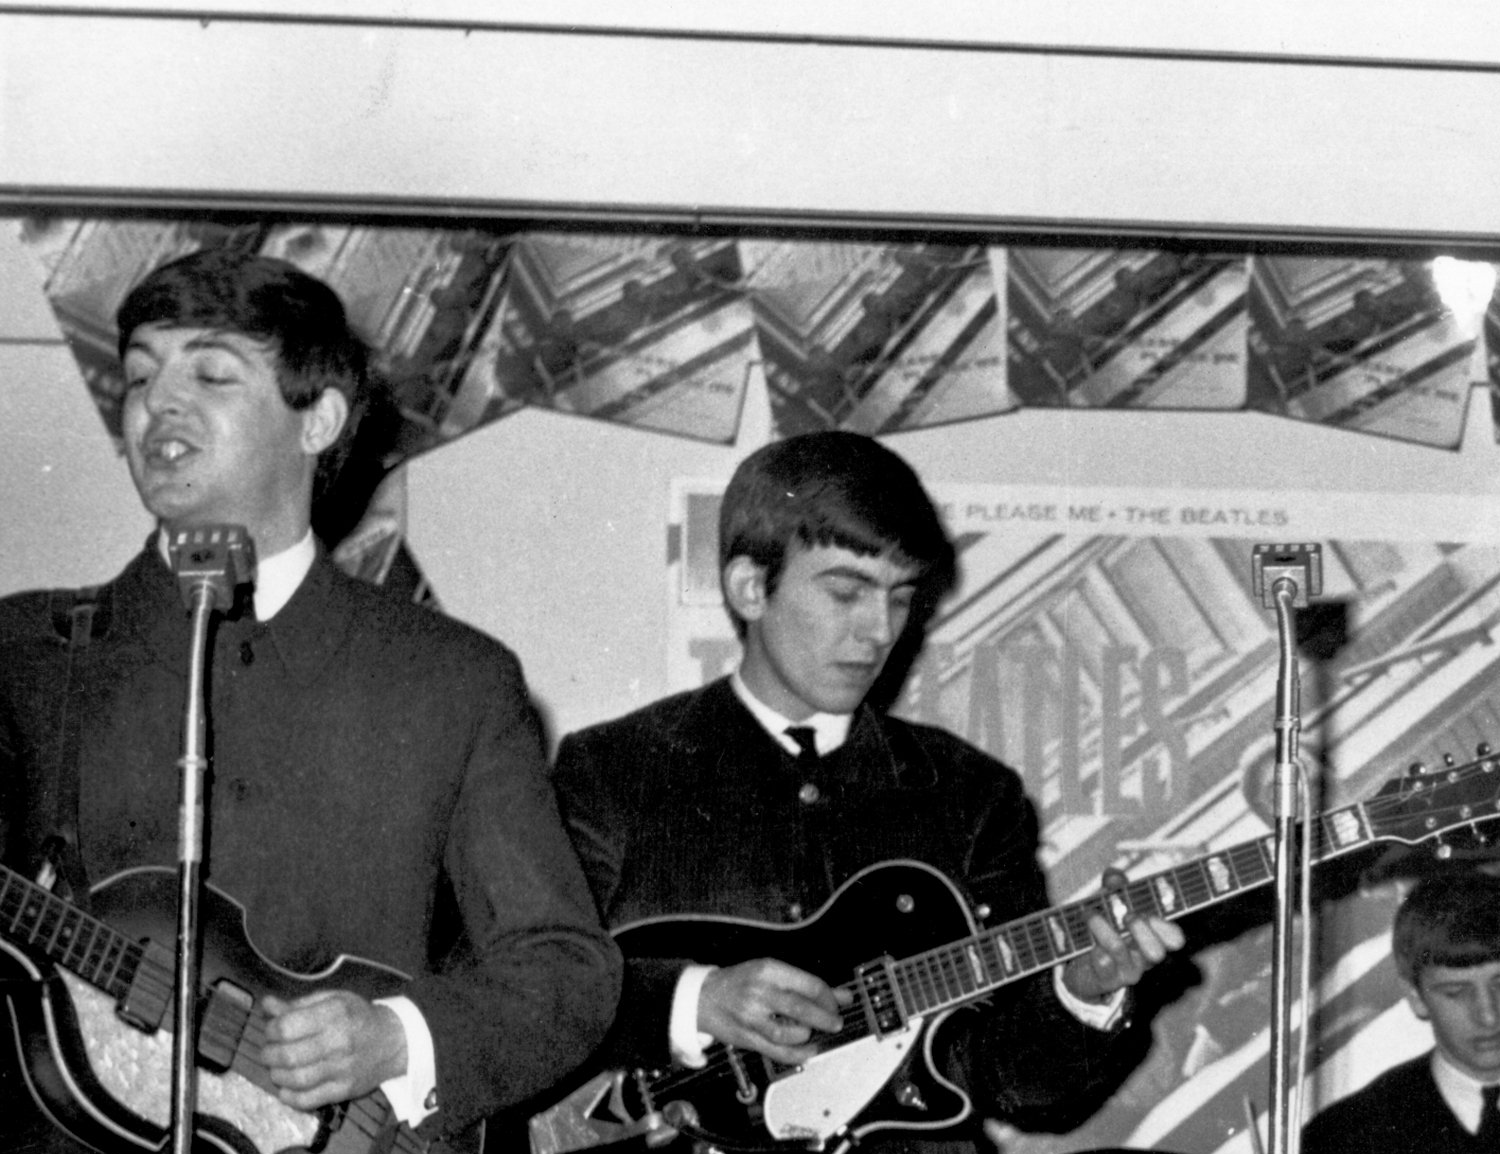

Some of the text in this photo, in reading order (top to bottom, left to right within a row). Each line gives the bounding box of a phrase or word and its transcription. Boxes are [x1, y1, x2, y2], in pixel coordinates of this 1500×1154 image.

[965, 504, 1056, 522] PLEASE
[1068, 505, 1100, 523] ME
[1126, 506, 1171, 525] THE
[1180, 507, 1288, 526] BEATLES
